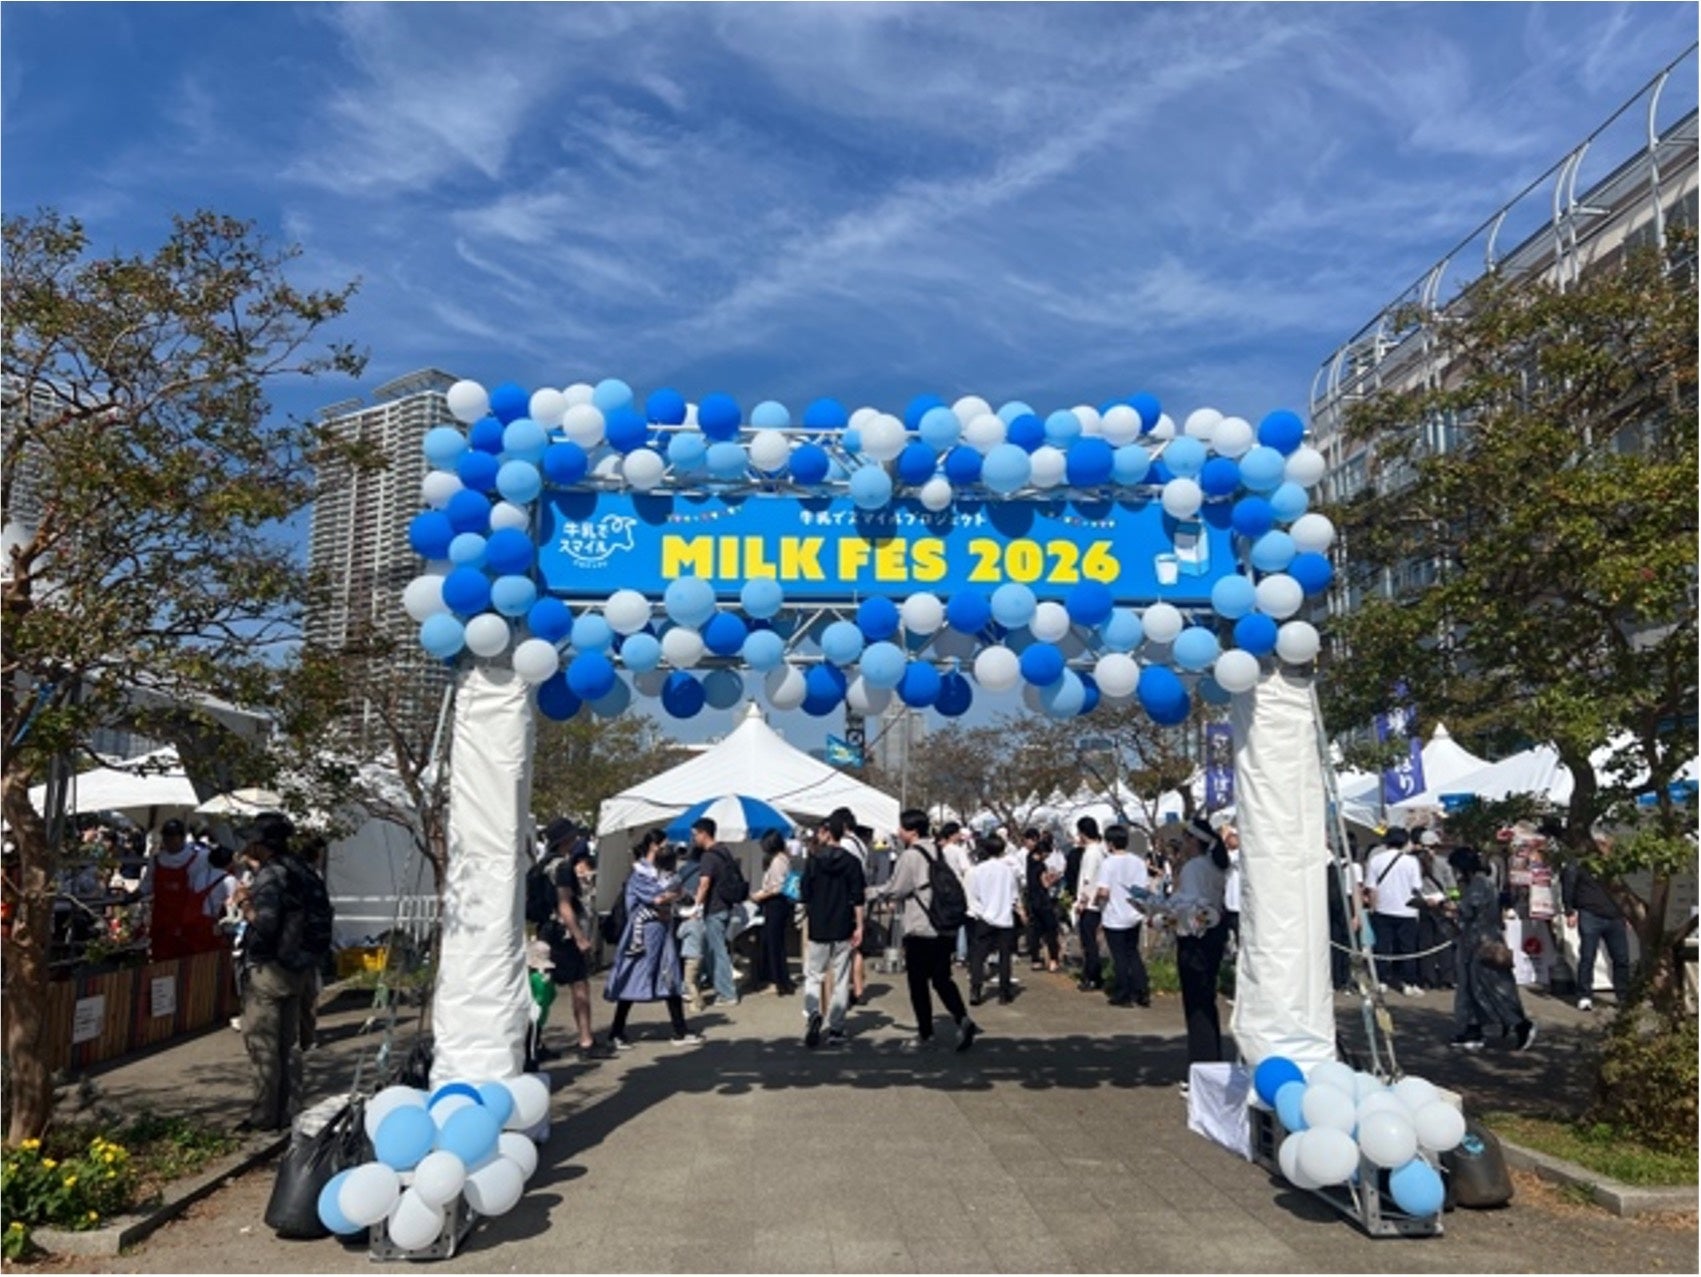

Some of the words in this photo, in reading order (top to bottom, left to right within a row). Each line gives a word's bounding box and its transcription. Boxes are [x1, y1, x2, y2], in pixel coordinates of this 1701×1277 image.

[563, 521, 608, 539] 牛乳で
[558, 538, 607, 555] スマイル
[661, 535, 826, 580] MILK
[838, 537, 948, 582] FES
[967, 539, 1121, 584] 2026
